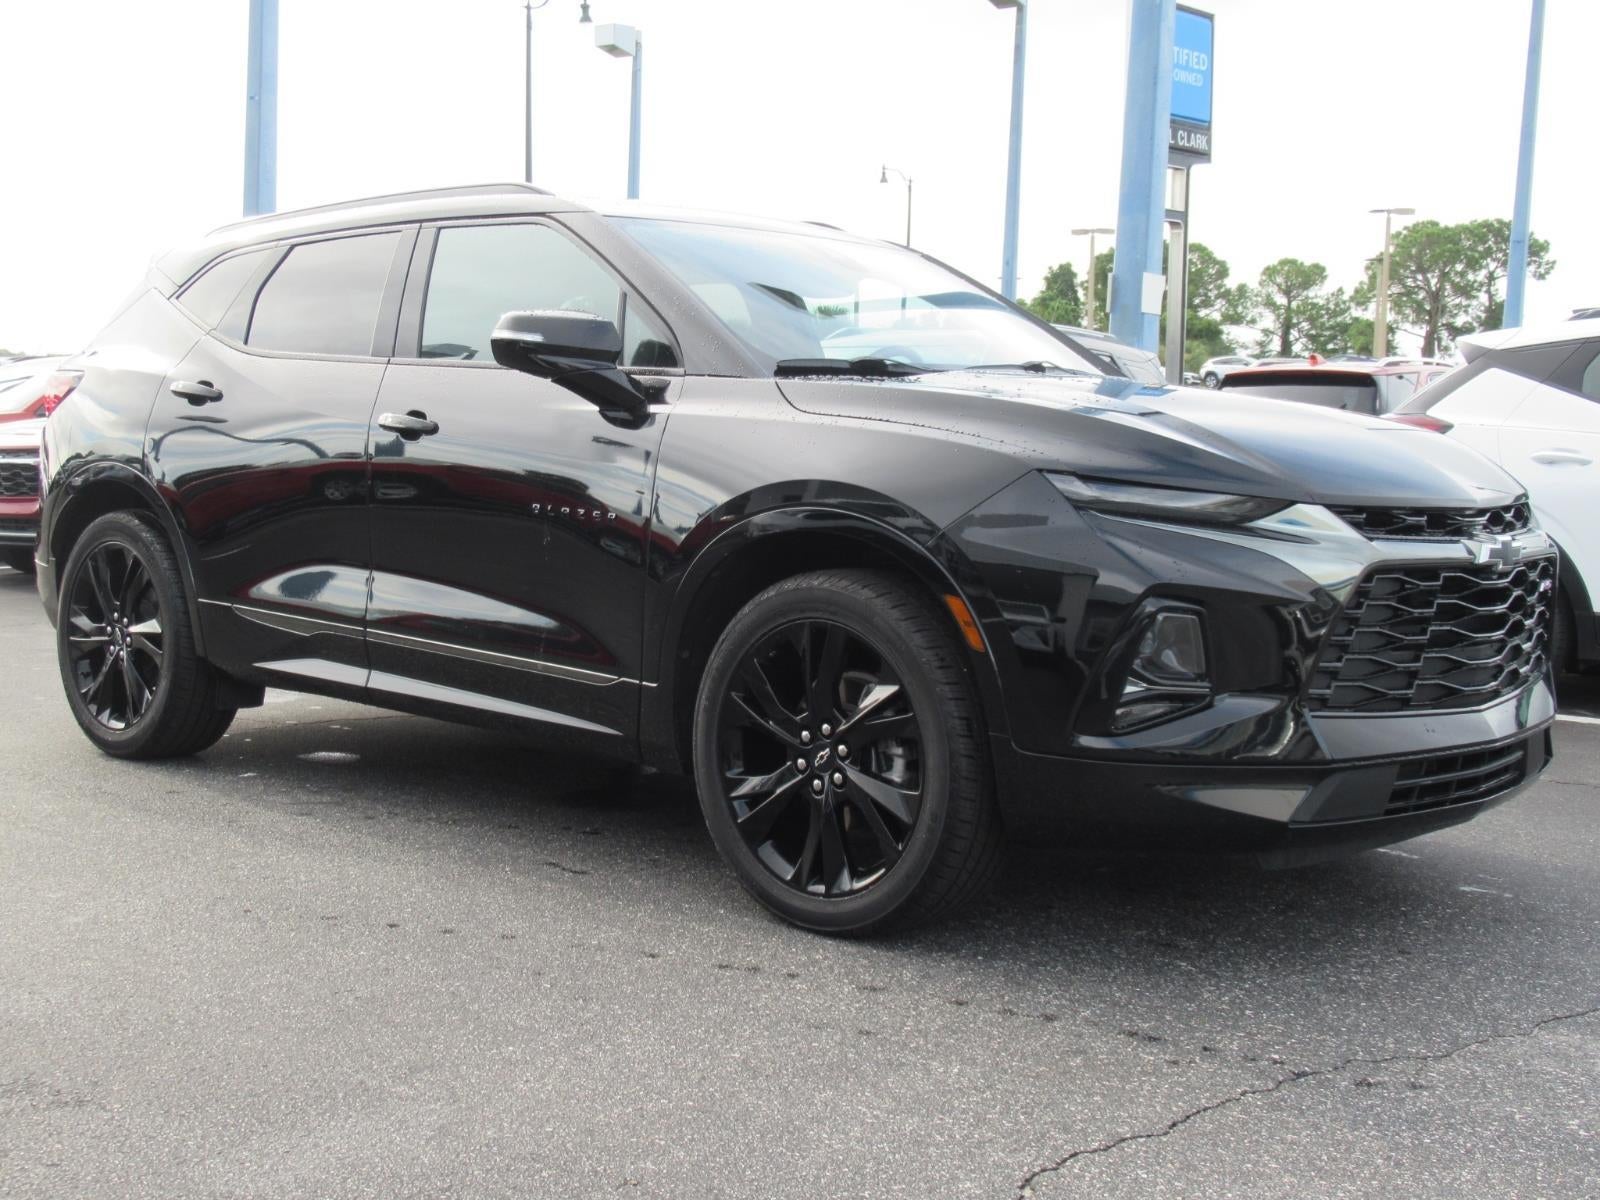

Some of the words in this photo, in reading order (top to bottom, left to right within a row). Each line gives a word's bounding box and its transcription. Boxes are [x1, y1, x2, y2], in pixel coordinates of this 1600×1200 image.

[1173, 46, 1208, 71] TIFIED
[1173, 68, 1204, 87] OWNED
[1177, 130, 1209, 150] CLARK
[532, 503, 617, 521] BLAZER
